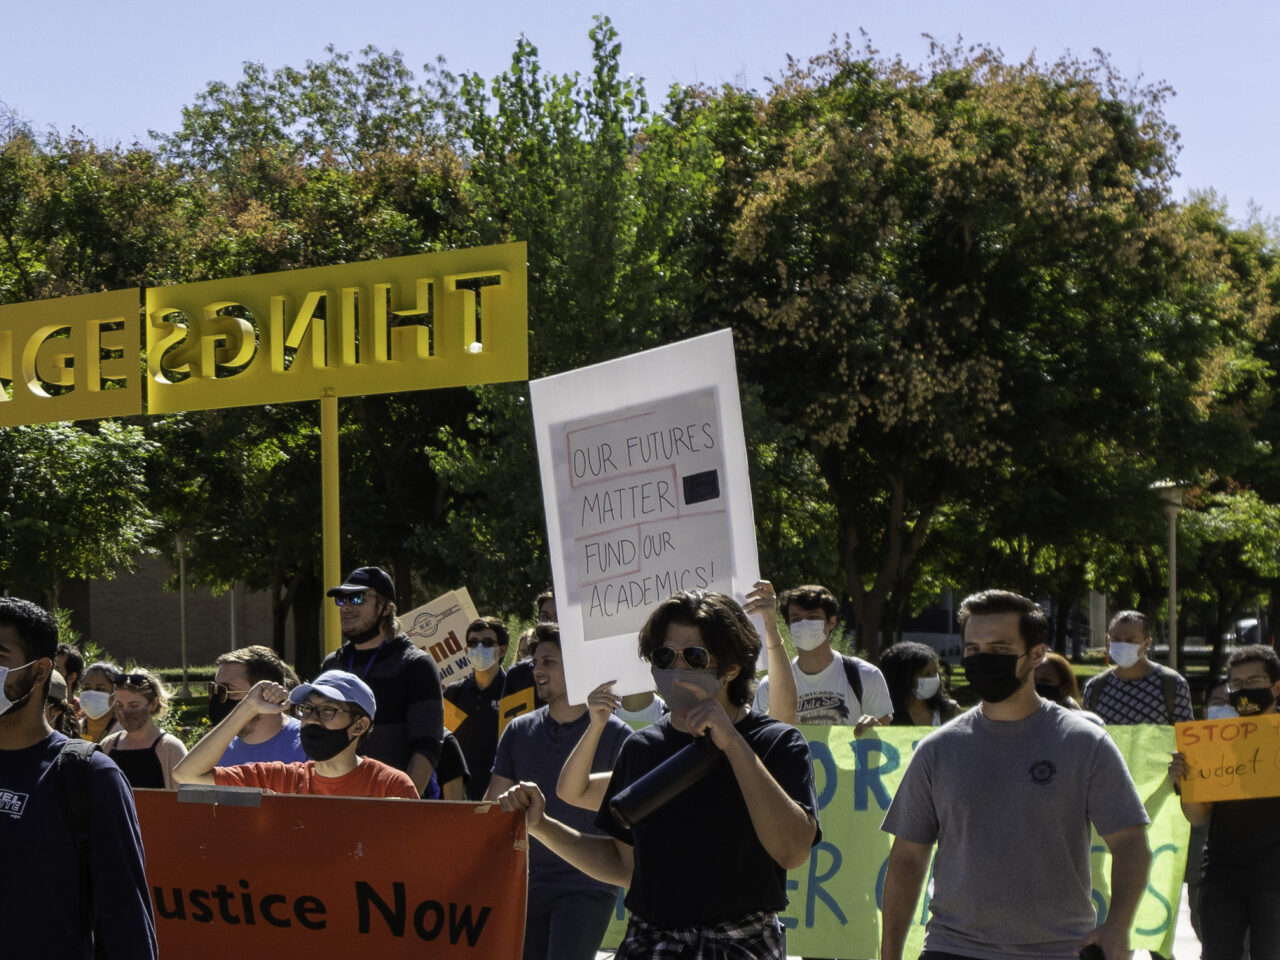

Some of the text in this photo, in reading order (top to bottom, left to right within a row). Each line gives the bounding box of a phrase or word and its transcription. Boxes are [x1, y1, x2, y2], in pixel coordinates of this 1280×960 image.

[572, 422, 716, 478] OUR FUTURES
[581, 480, 676, 527] MATTER
[584, 531, 676, 574] FUND OUR
[589, 561, 716, 618] ACADEMICS!
[420, 630, 463, 664] nd
[1182, 722, 1258, 746] STOP
[153, 879, 492, 947] ustice Now
